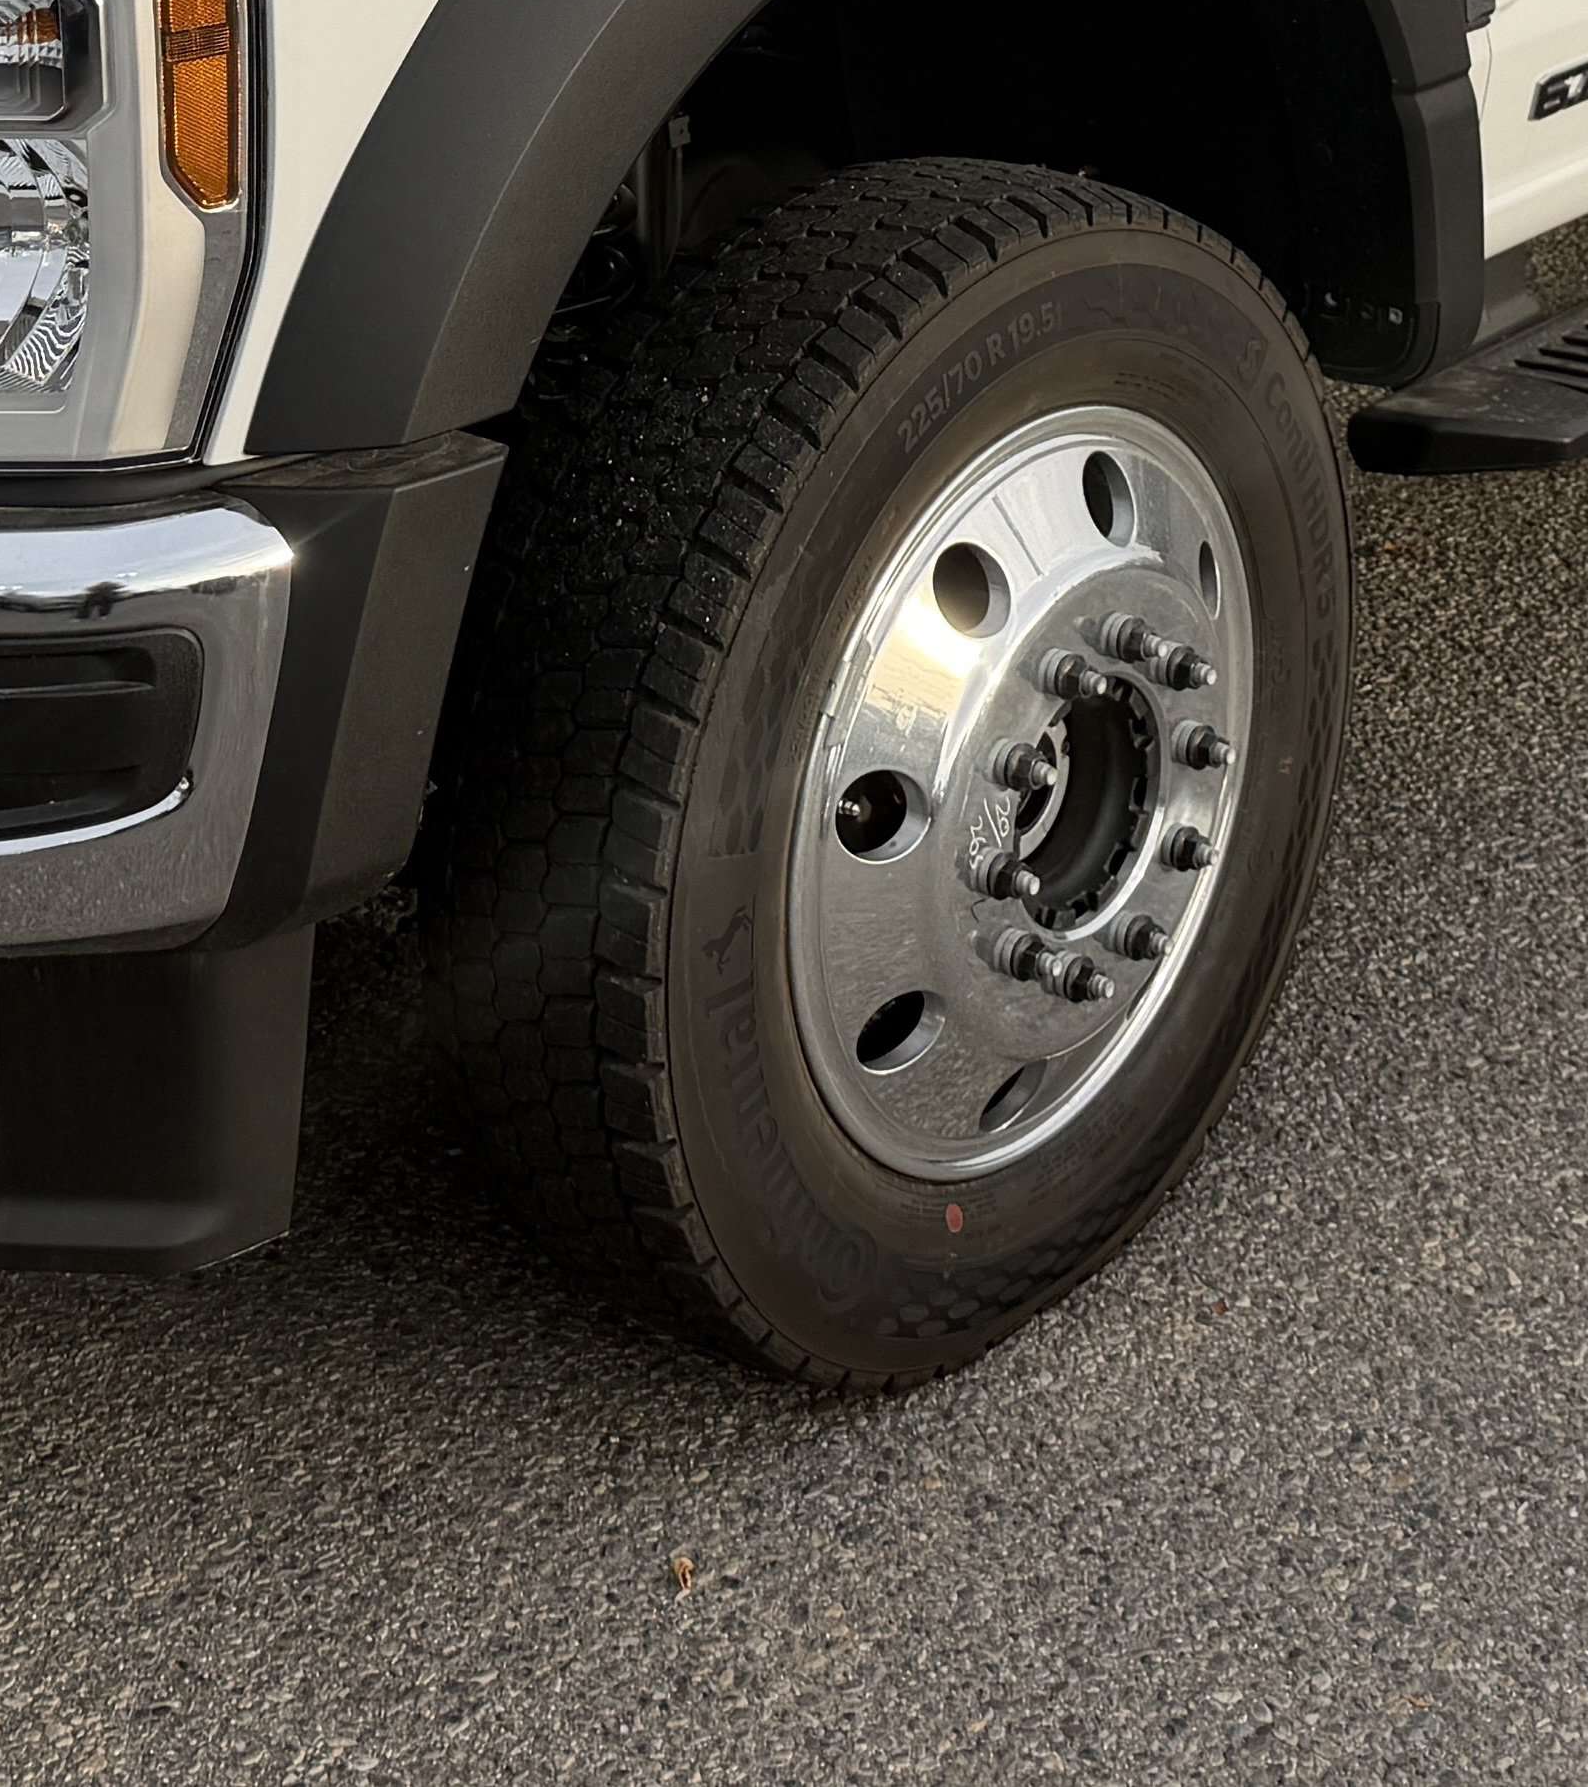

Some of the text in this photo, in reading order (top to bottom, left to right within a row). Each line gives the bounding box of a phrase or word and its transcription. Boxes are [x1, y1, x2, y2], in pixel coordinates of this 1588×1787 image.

[897, 301, 1054, 454] 225/70 R 19.5
